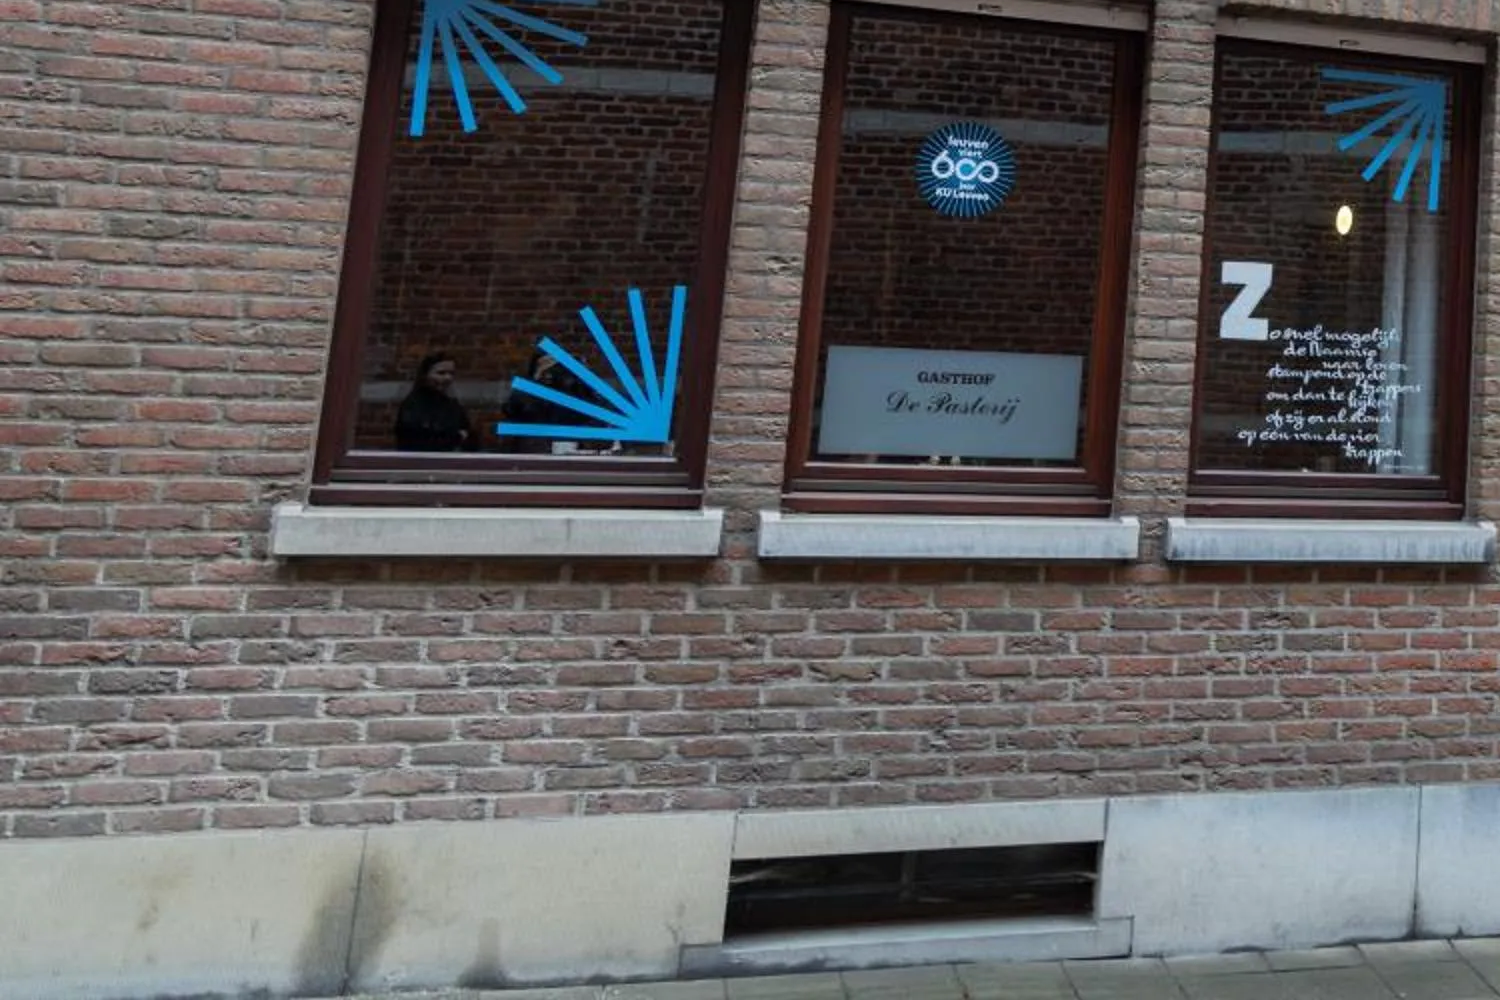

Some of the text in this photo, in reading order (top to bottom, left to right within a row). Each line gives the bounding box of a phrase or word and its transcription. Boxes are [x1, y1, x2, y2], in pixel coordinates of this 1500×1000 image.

[936, 187, 952, 197] KU
[1325, 327, 1400, 348] mogelijk
[1284, 342, 1307, 356] de
[917, 371, 996, 385] GASTHOF
[1348, 371, 1366, 386] op
[1367, 367, 1387, 381] de
[1266, 391, 1289, 401] om
[1292, 388, 1324, 401] dan
[1329, 386, 1347, 401] te
[886, 390, 1020, 424] De Pastorij
[1266, 410, 1284, 426] of
[1327, 407, 1347, 423] al
[1237, 431, 1258, 446] op
[1293, 431, 1323, 441] van
[1325, 428, 1347, 441] de
[1348, 429, 1381, 443] vier
